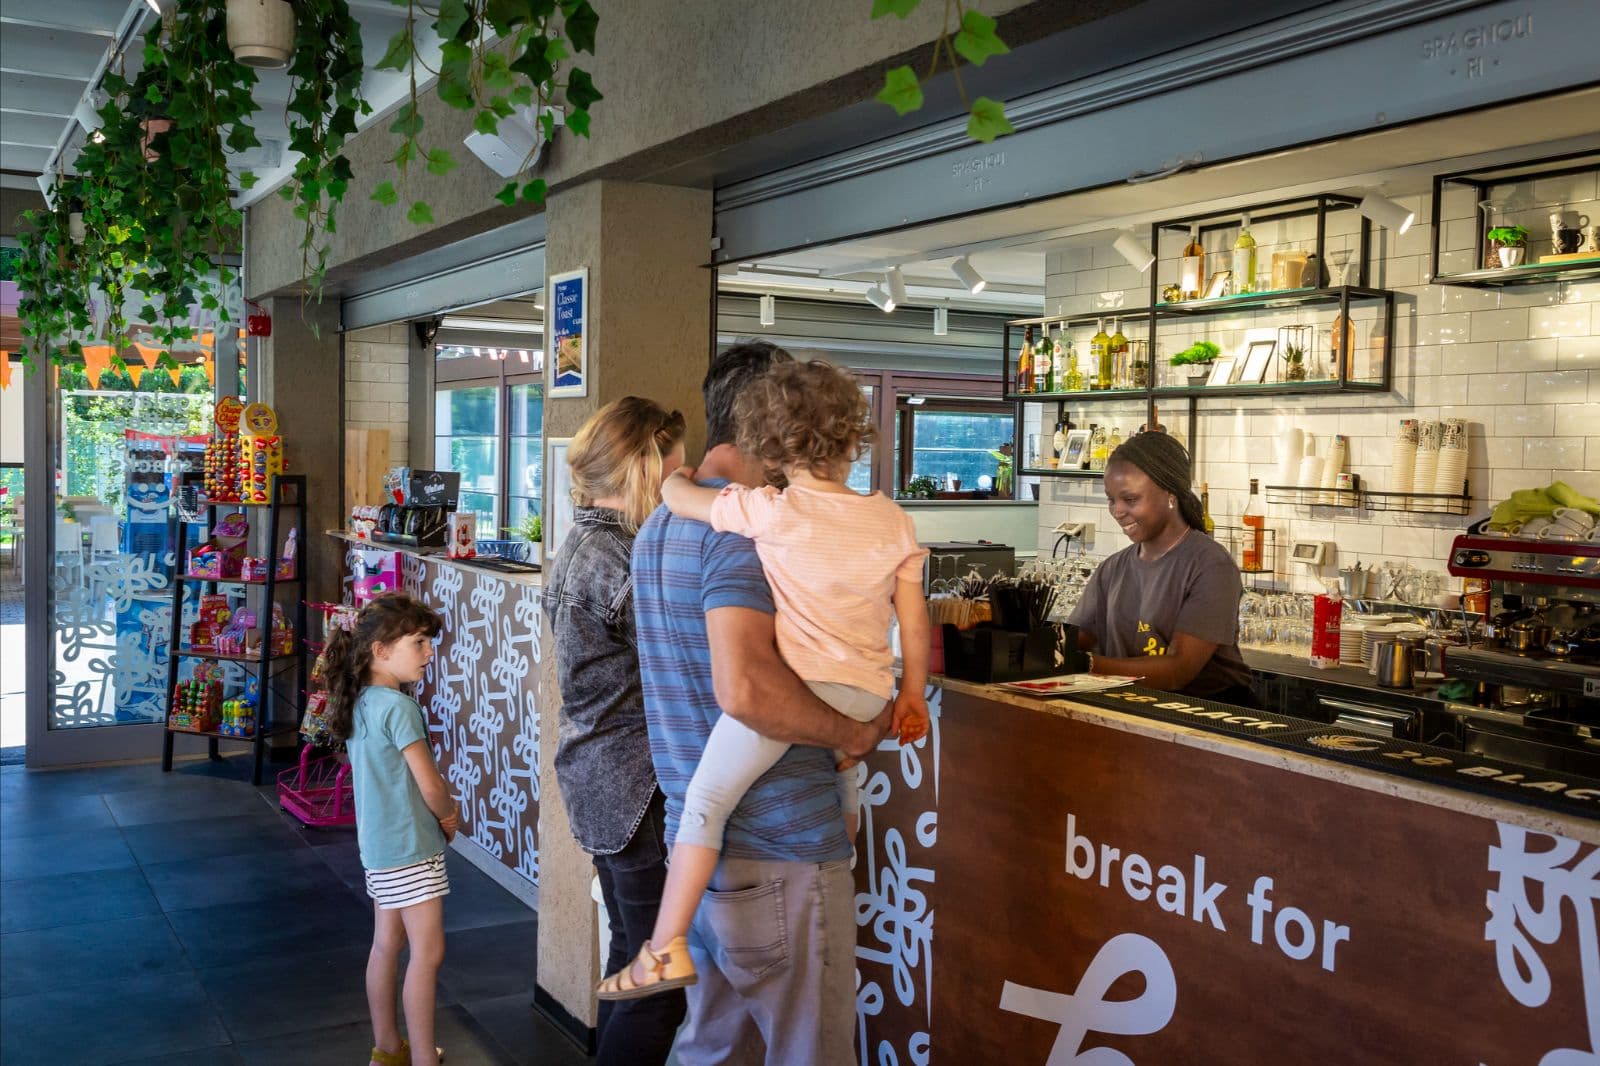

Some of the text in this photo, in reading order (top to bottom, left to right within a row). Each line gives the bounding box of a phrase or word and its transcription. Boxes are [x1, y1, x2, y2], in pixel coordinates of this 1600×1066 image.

[1152, 702, 1288, 730] BLACK
[1456, 766, 1600, 804] BLAC
[1065, 813, 1350, 972] break for
